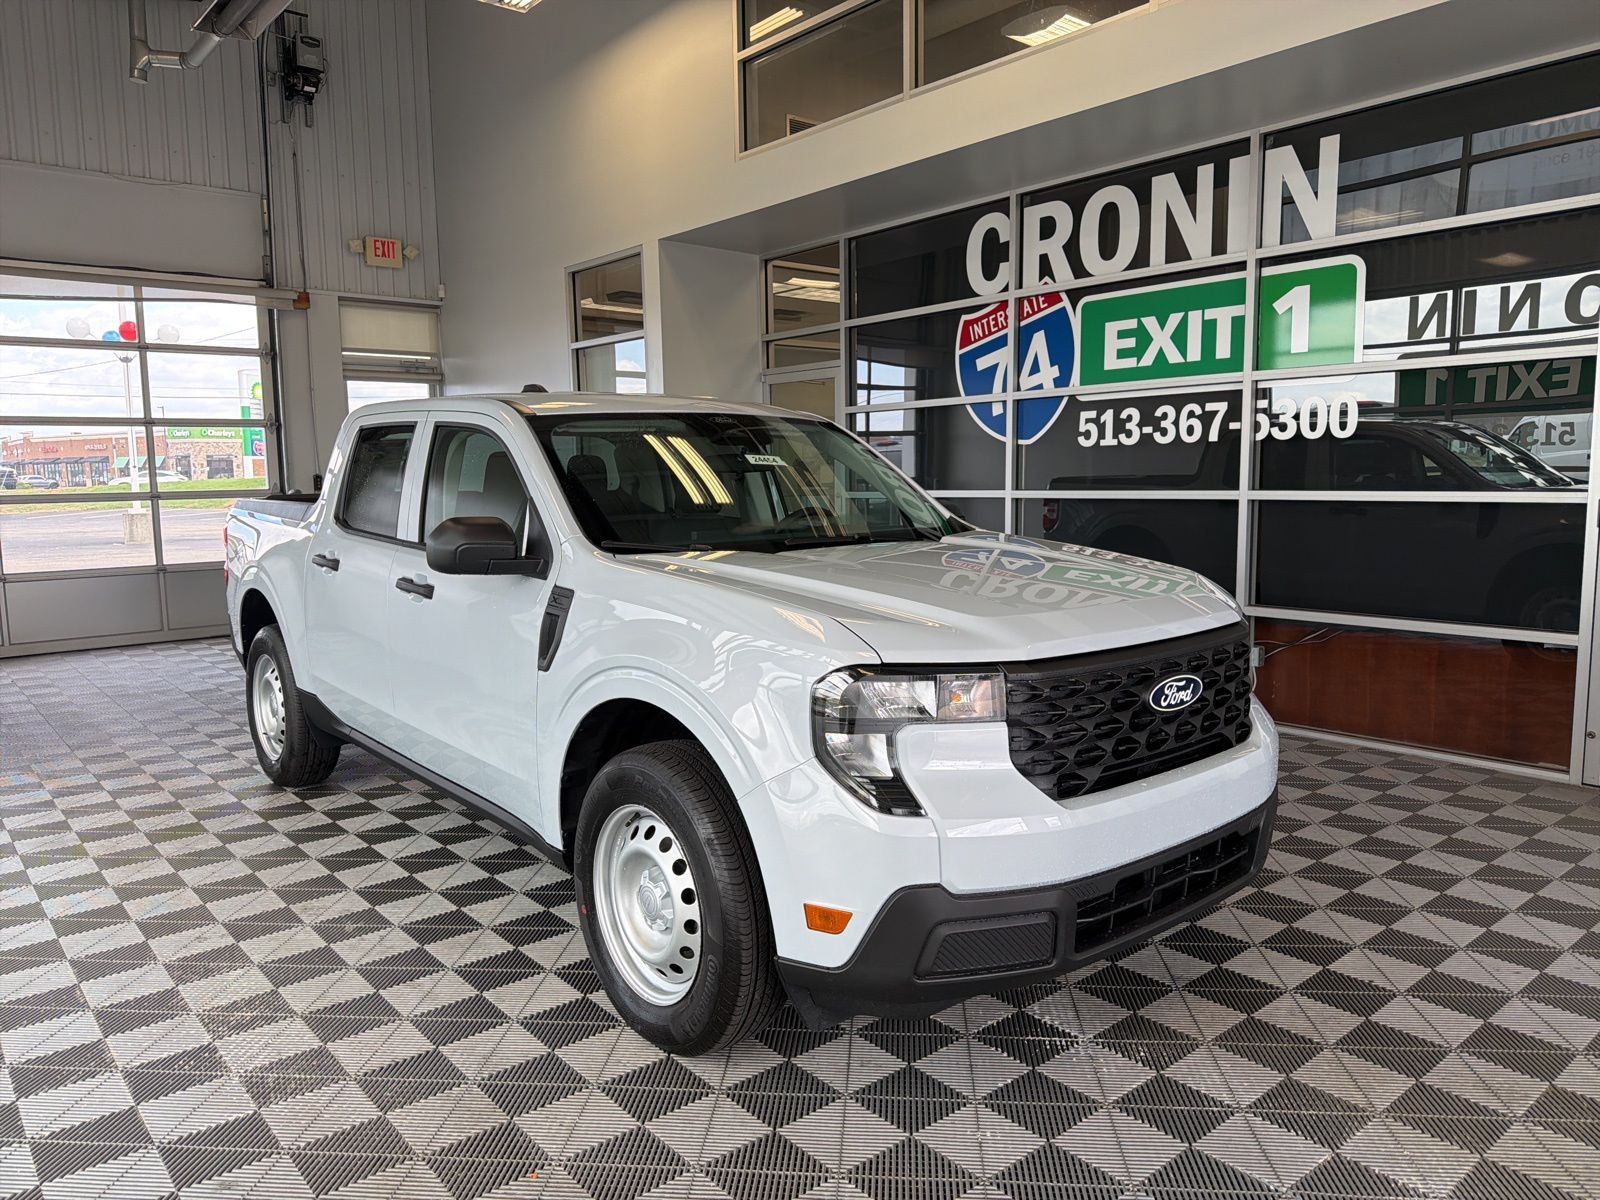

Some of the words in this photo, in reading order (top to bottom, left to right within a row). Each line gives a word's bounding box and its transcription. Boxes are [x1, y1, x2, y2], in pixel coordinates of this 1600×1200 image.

[966, 134, 1340, 296] CRONIN
[373, 239, 397, 260] EXIT
[968, 295, 1049, 342] INTERATE
[1104, 304, 1246, 370] EXIT
[1272, 284, 1311, 353] 1
[975, 329, 1060, 417] 74
[1077, 395, 1359, 447] 513-367-5300
[1160, 680, 1194, 707] Ford
